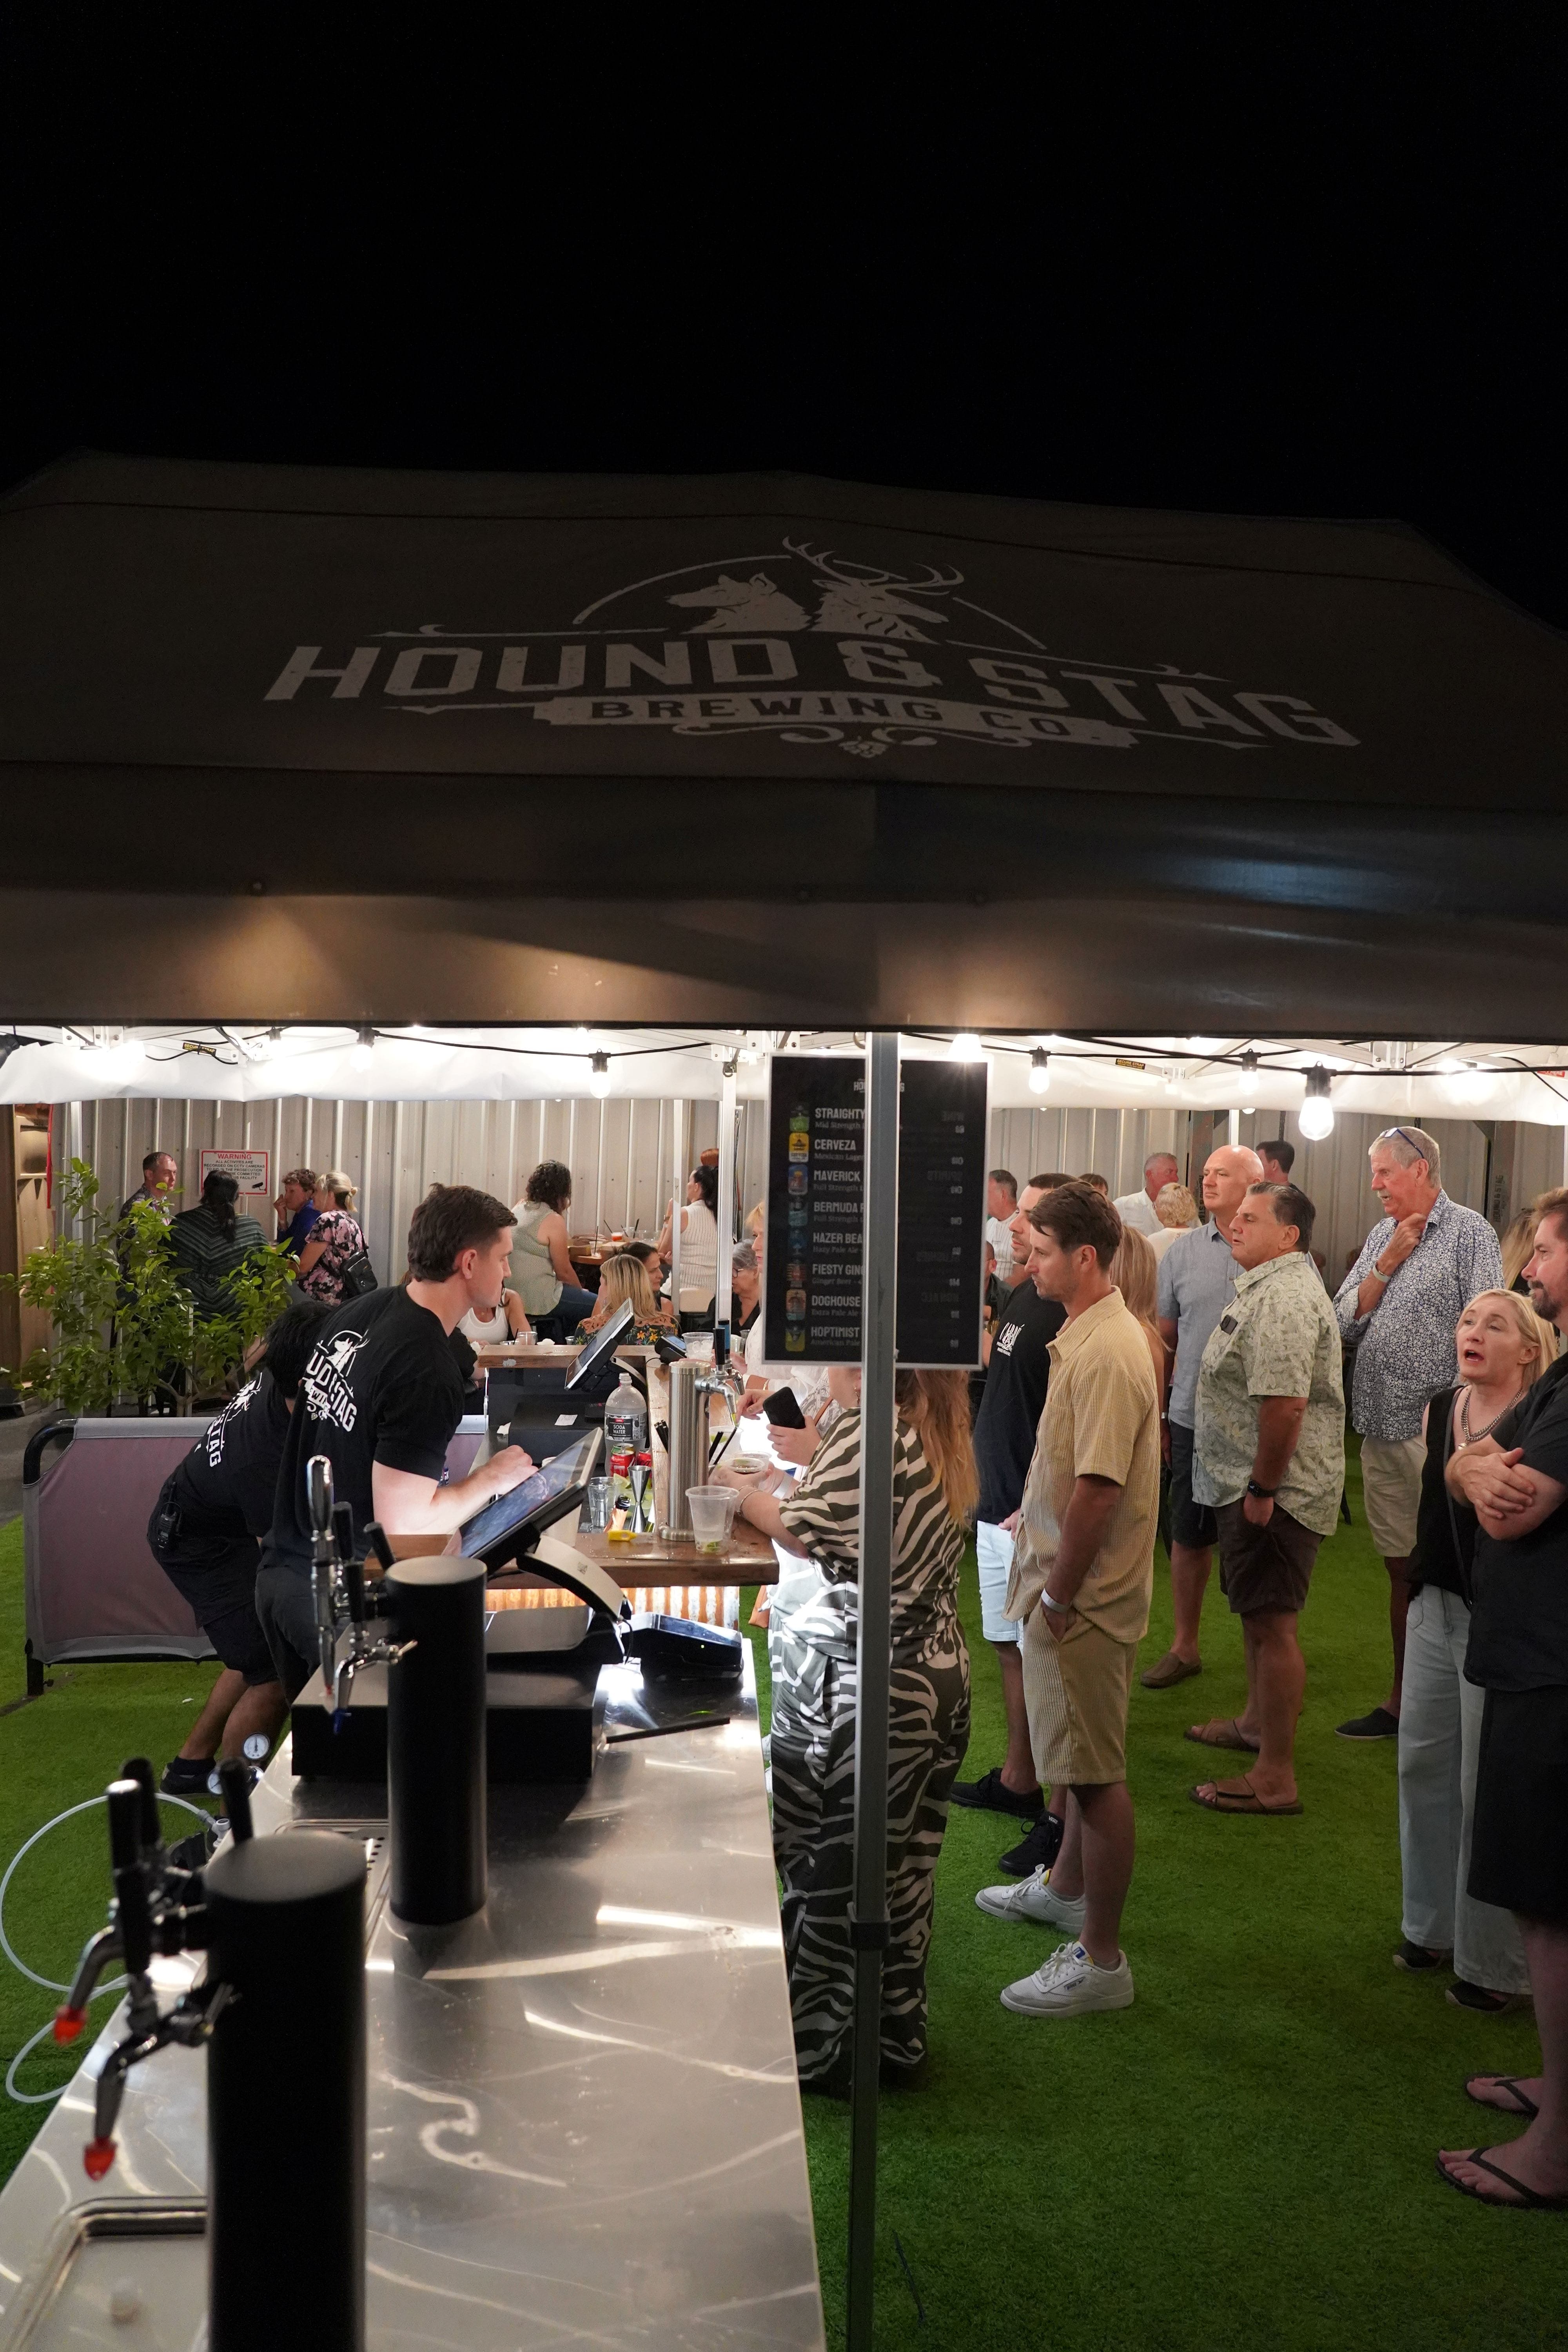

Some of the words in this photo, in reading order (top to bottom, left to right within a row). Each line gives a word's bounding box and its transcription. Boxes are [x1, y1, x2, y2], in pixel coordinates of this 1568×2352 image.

[264, 638, 798, 700] HOUND
[838, 641, 942, 687] &
[968, 657, 1361, 746] STAG
[591, 697, 943, 720] BREWING
[815, 1139, 856, 1151] CERVEZA
[814, 1170, 860, 1181] MAVERICK
[814, 1201, 858, 1212] BERMUDA
[813, 1232, 843, 1243] HAZER
[845, 1233, 862, 1243] BEA
[812, 1263, 843, 1275] FIESTY
[812, 1295, 860, 1307] DOGHOUSE
[811, 1326, 860, 1338] HOPTIMIST
[1049, 1815, 1058, 1824] VANS
